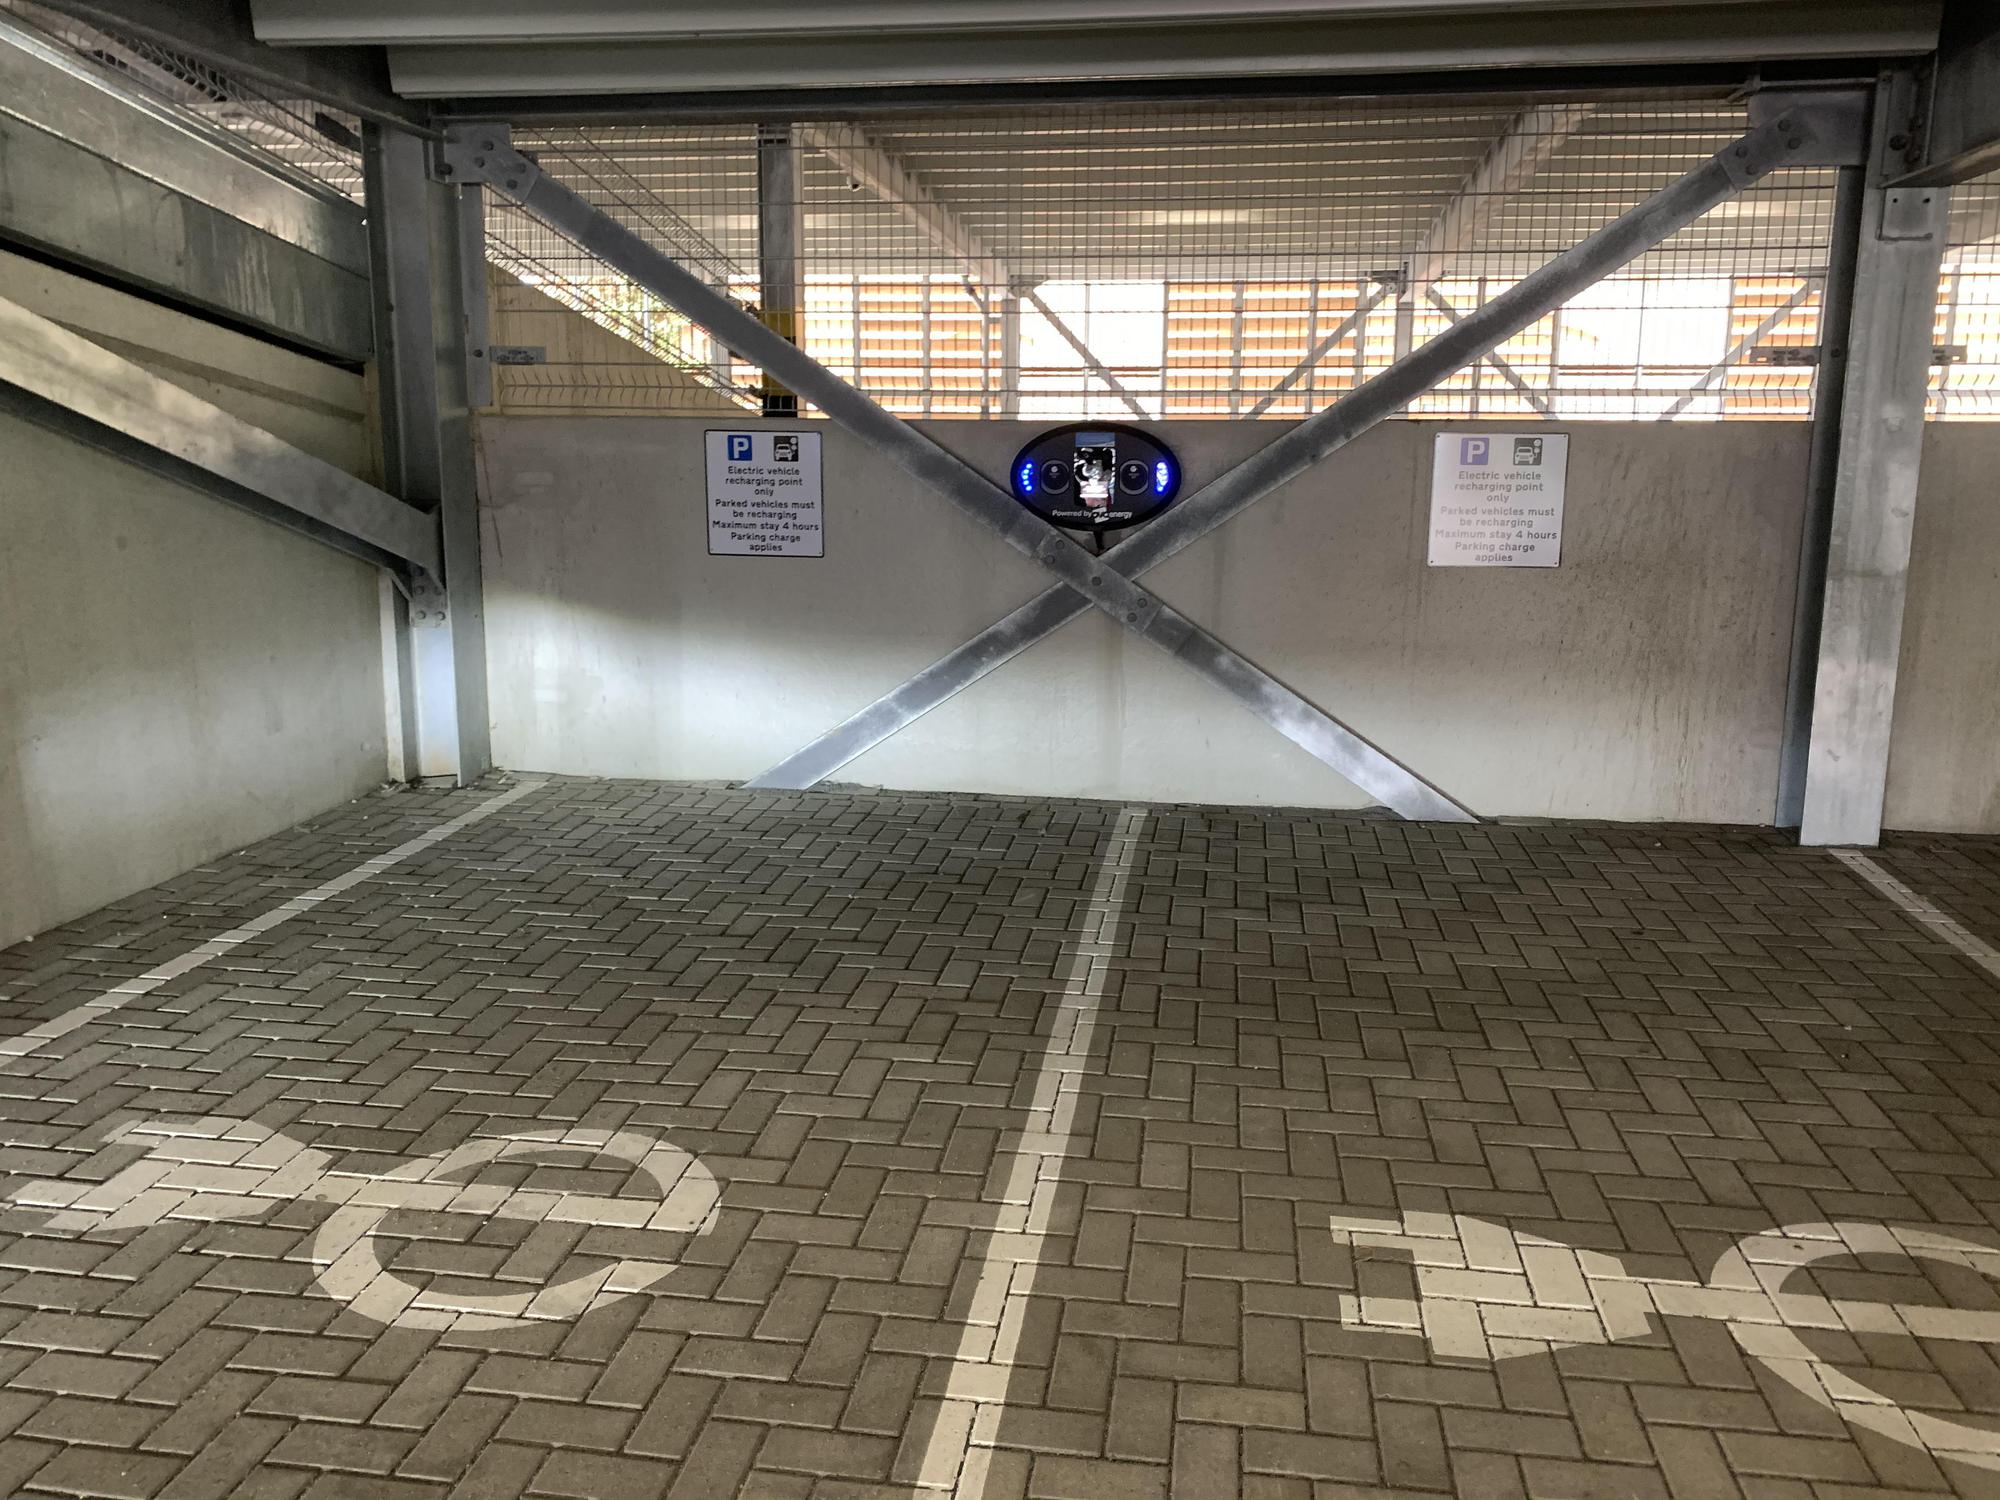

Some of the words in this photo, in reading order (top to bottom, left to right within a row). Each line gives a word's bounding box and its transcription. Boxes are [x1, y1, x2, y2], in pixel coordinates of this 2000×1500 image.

[734, 438, 748, 459] P
[1467, 441, 1485, 463] P
[728, 466, 764, 474] Electric
[767, 467, 799, 475] vehicle
[1459, 471, 1499, 480] Electric
[1504, 472, 1541, 480] vehicle
[726, 477, 775, 486] recharging
[1455, 482, 1511, 491] recharging
[1516, 483, 1543, 491] point
[754, 488, 773, 496] only
[1487, 493, 1509, 503] only
[716, 499, 747, 507] Parked
[751, 500, 788, 508] vehicles
[792, 501, 815, 509] must
[748, 511, 797, 519] recharging
[1052, 509, 1082, 518] Powered
[1084, 510, 1092, 518] by
[1441, 507, 1477, 515] Parked
[1482, 507, 1524, 515] vehicles
[1528, 508, 1555, 516] must
[713, 521, 756, 529] Maximum
[761, 522, 779, 531] stay
[793, 522, 818, 530] hours
[1476, 519, 1533, 528] recharging
[731, 532, 766, 542] Parking
[769, 533, 800, 542] charge
[1435, 530, 1486, 538] Maximum
[1489, 530, 1512, 539] stay
[1527, 531, 1557, 539] hours
[750, 543, 782, 551] applies
[1456, 542, 1495, 551] Parking
[1499, 543, 1535, 552] charge
[1475, 554, 1512, 562] applies
